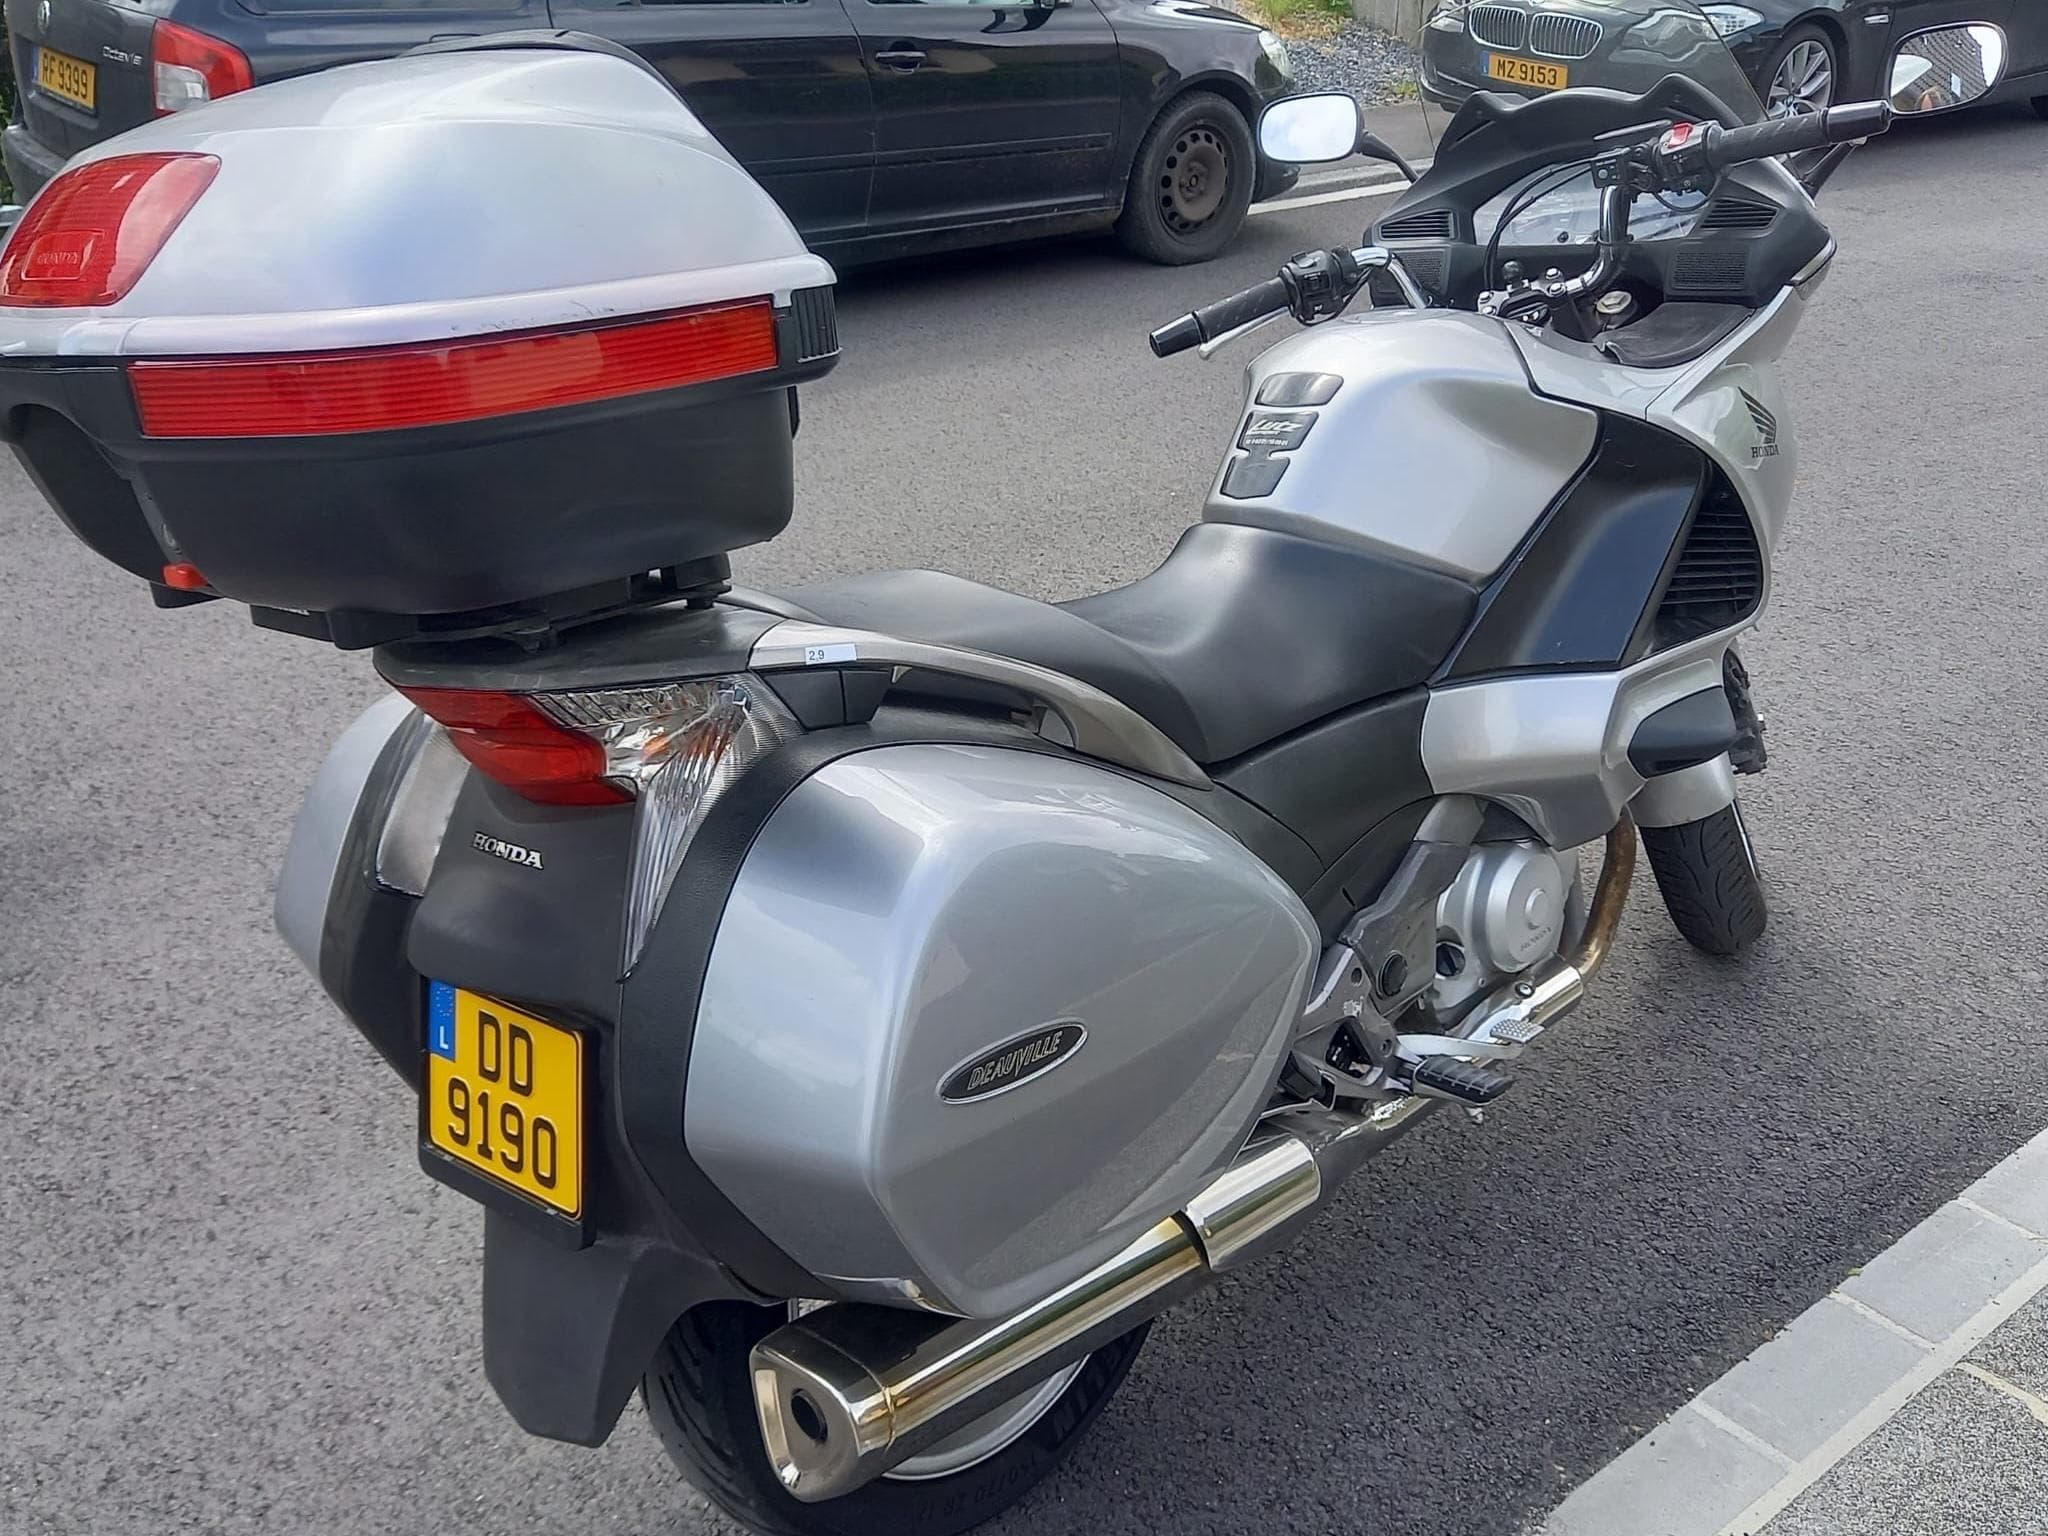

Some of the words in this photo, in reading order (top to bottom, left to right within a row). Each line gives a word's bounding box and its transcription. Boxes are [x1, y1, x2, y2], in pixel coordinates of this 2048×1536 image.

[42, 52, 56, 85] RF
[58, 60, 88, 100] 9399
[1497, 59, 1516, 79] MZ
[1519, 63, 1558, 86] 9153
[1751, 444, 1780, 458] HONDA
[473, 832, 544, 870] HONDA
[439, 1025, 449, 1050] L
[478, 1009, 534, 1097] DD
[967, 1030, 1063, 1091] DEAUVILLE
[448, 1077, 557, 1190] 9190
